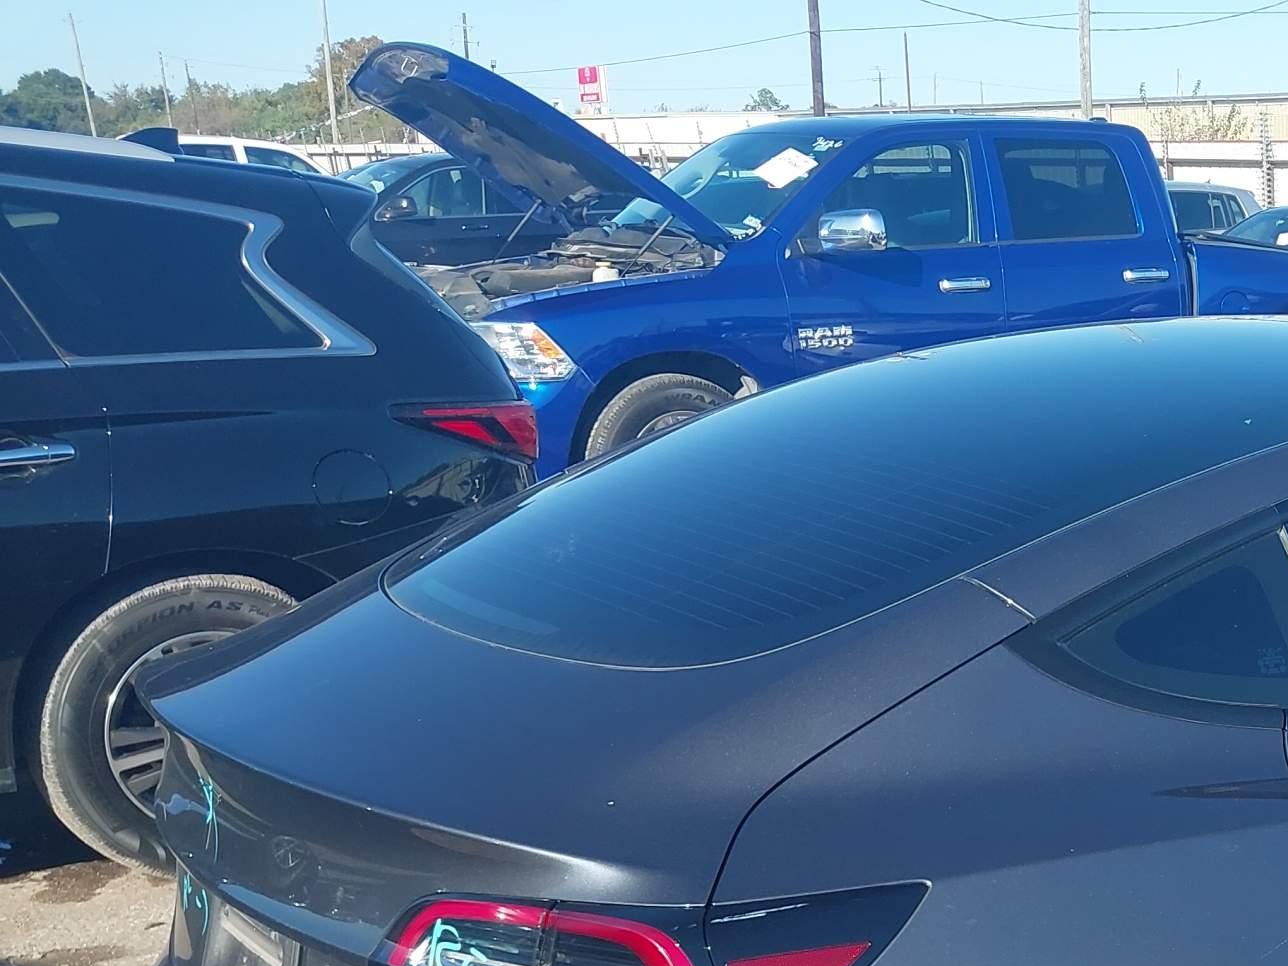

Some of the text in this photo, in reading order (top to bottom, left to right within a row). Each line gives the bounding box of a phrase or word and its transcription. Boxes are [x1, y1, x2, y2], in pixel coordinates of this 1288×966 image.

[797, 325, 853, 339] RAM
[799, 337, 854, 349] 1500
[207, 600, 243, 612] AS
